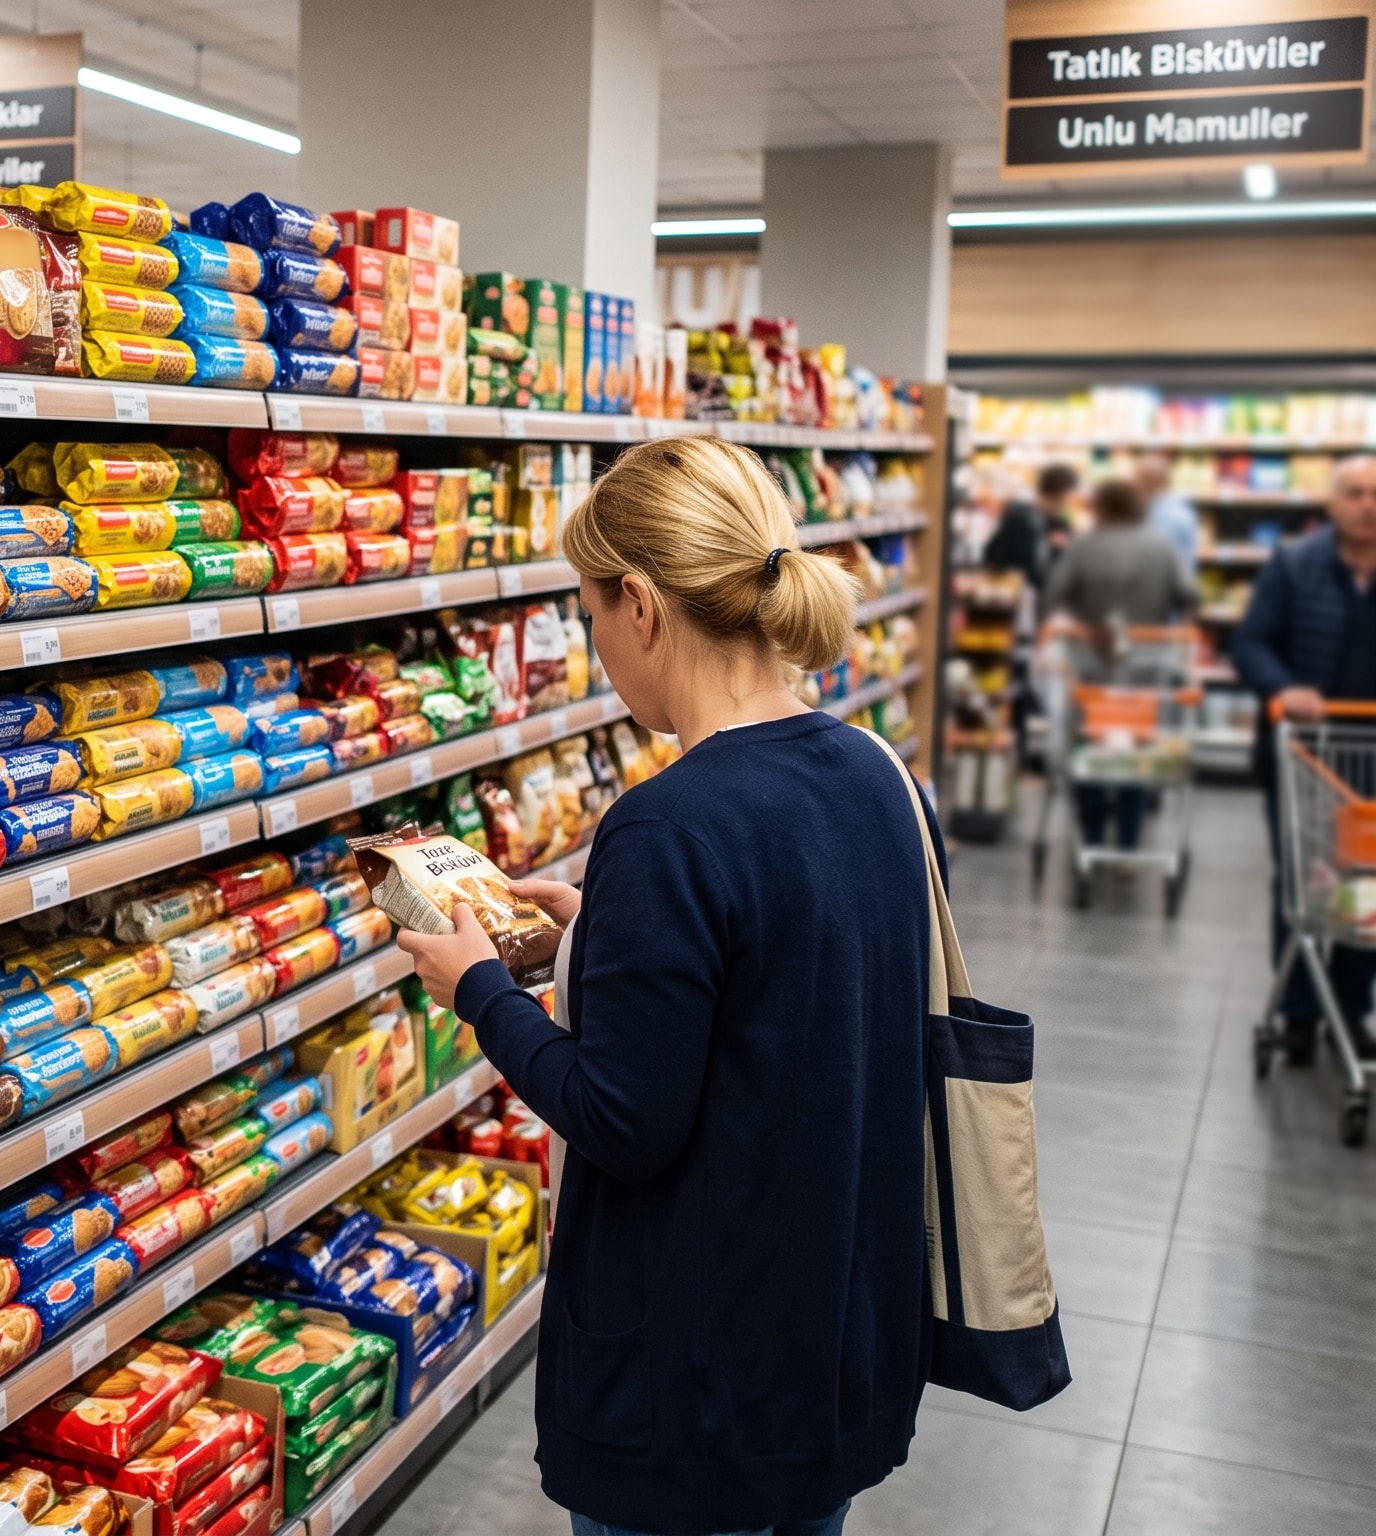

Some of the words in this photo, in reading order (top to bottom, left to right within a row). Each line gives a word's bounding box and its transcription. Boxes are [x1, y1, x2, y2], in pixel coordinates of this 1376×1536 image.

[1048, 46, 1142, 81] Tatlık
[1151, 36, 1325, 76] Bisküviler
[1058, 114, 1135, 148] Unlu
[1145, 107, 1308, 144] Mamuller
